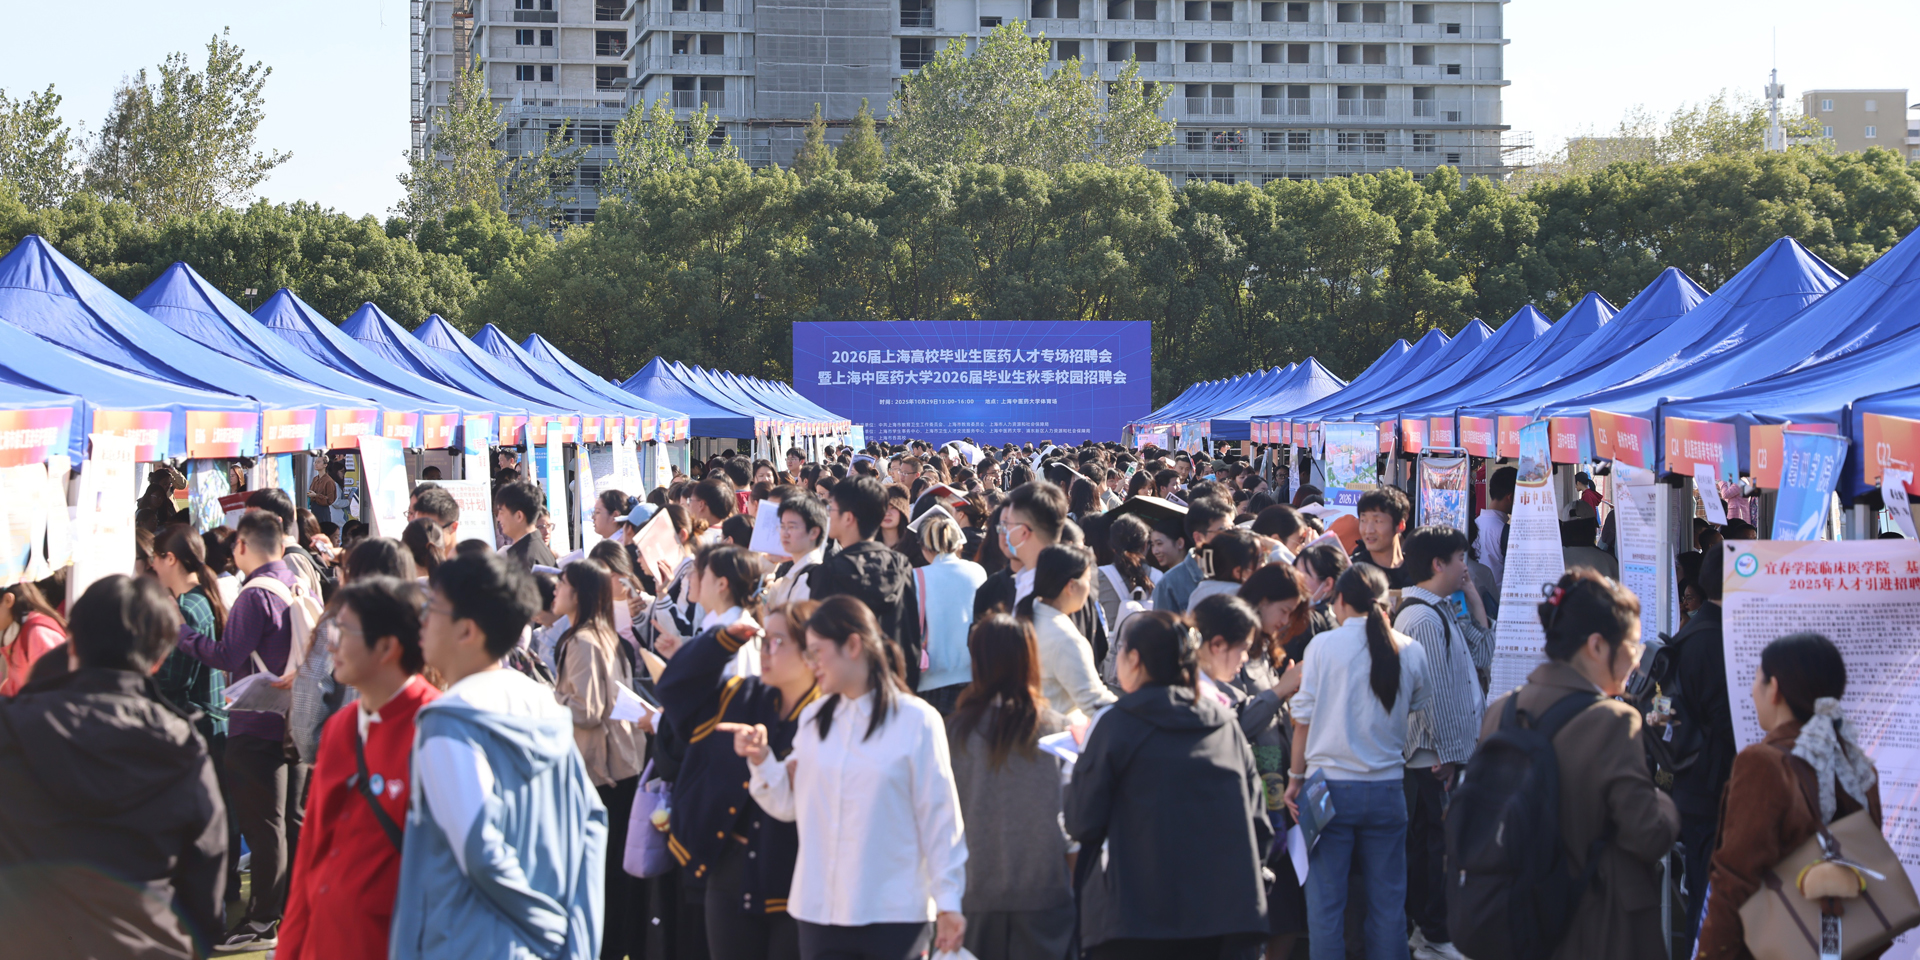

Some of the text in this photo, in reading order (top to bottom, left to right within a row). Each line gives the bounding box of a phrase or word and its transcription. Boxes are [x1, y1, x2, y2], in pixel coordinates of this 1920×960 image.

[832, 348, 1113, 364] 2026届上海高校毕业生医药人才专场招聘会
[817, 370, 1127, 385] 暨上海中医药大学2026届毕业生秋季校园招聘会
[1789, 577, 1920, 592] 2025年人才引进招聘
